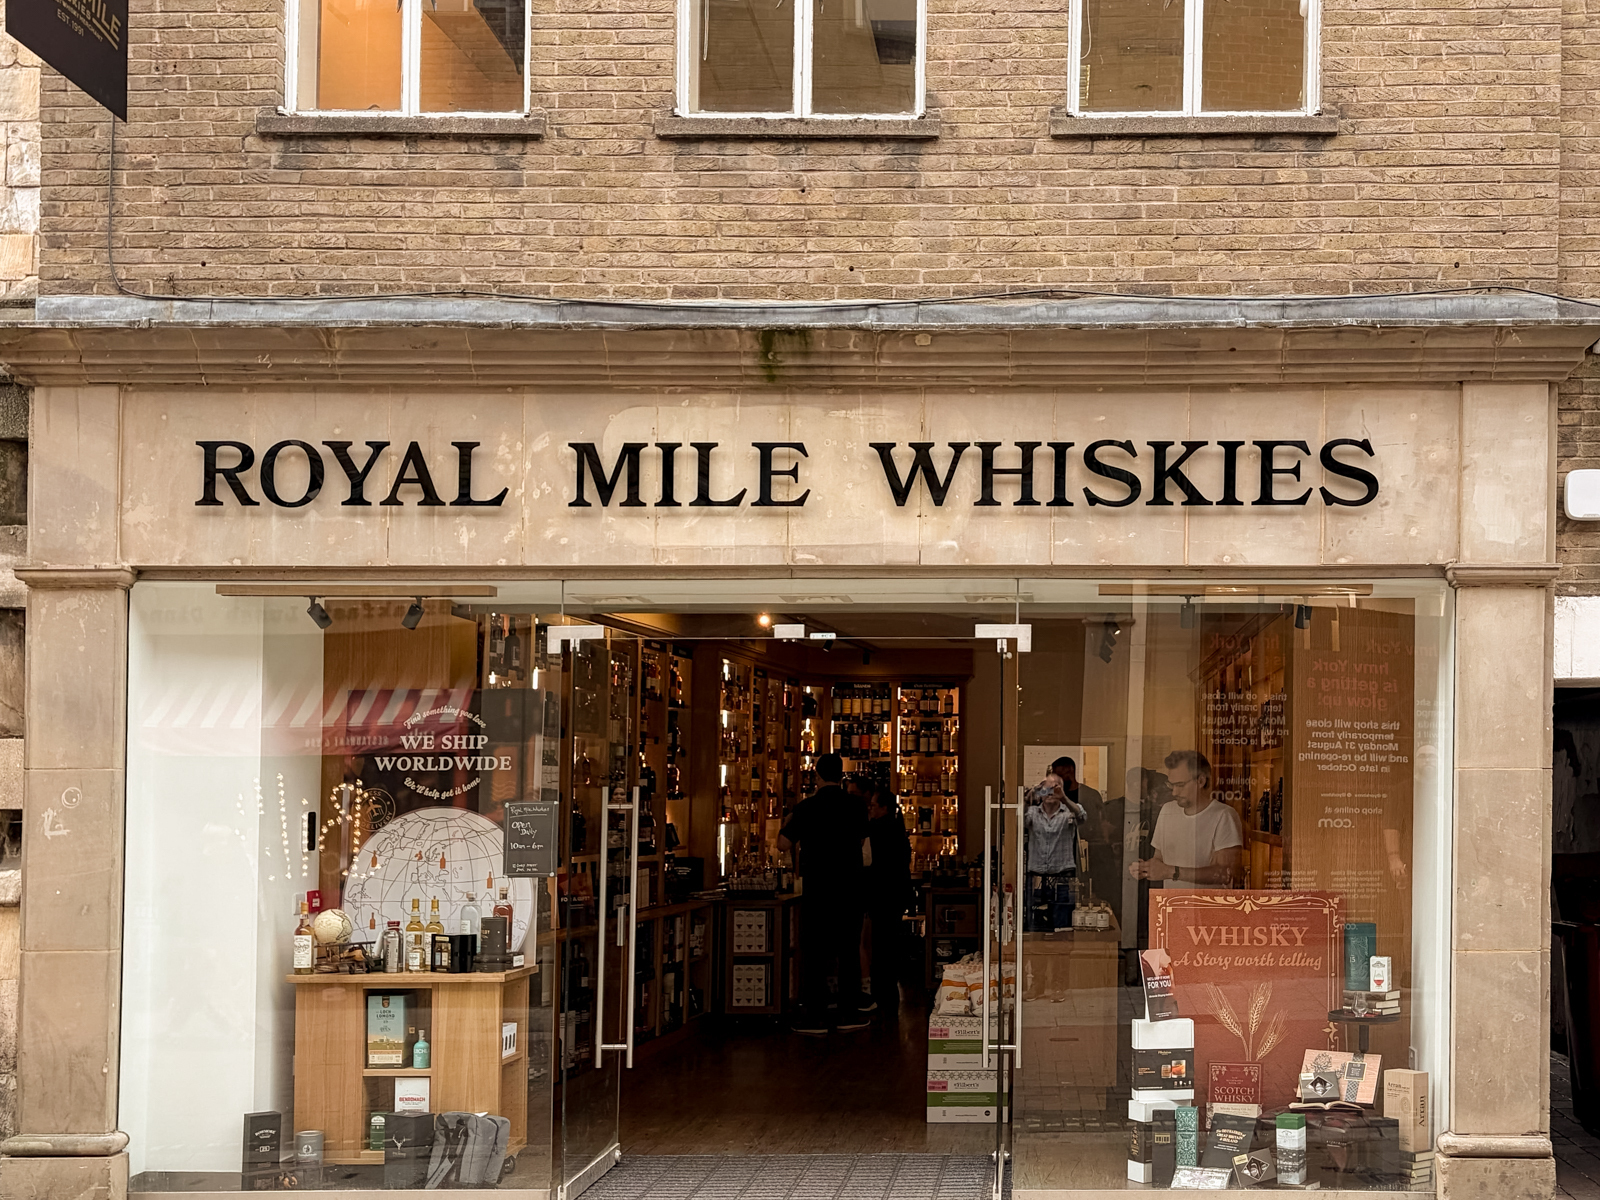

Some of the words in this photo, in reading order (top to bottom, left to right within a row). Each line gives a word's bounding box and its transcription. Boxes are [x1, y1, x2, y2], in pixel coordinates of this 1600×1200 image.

[71, 20, 84, 37] 1991
[195, 440, 508, 507] ROYAL
[569, 443, 810, 506] MILE
[869, 439, 1378, 507] WHISKIES
[403, 712, 422, 729] Find
[422, 705, 460, 718] something
[460, 709, 473, 718] you
[473, 715, 487, 728] love
[400, 735, 434, 749] WE
[442, 735, 489, 749] SHIP
[374, 756, 512, 771] WORLDWIDE
[404, 777, 425, 794] We'll
[424, 787, 440, 799] help
[441, 788, 454, 799] get
[455, 785, 462, 796] it
[462, 777, 481, 793] home
[511, 821, 531, 831] Open
[1187, 925, 1309, 947] WHISKY
[1174, 953, 1191, 966] A
[1193, 951, 1231, 970] Story
[1233, 954, 1275, 967] worth
[1278, 951, 1323, 970] telling
[1147, 981, 1159, 989] FOR
[1160, 980, 1171, 988] YOU
[1214, 1086, 1254, 1094] SCOTCH
